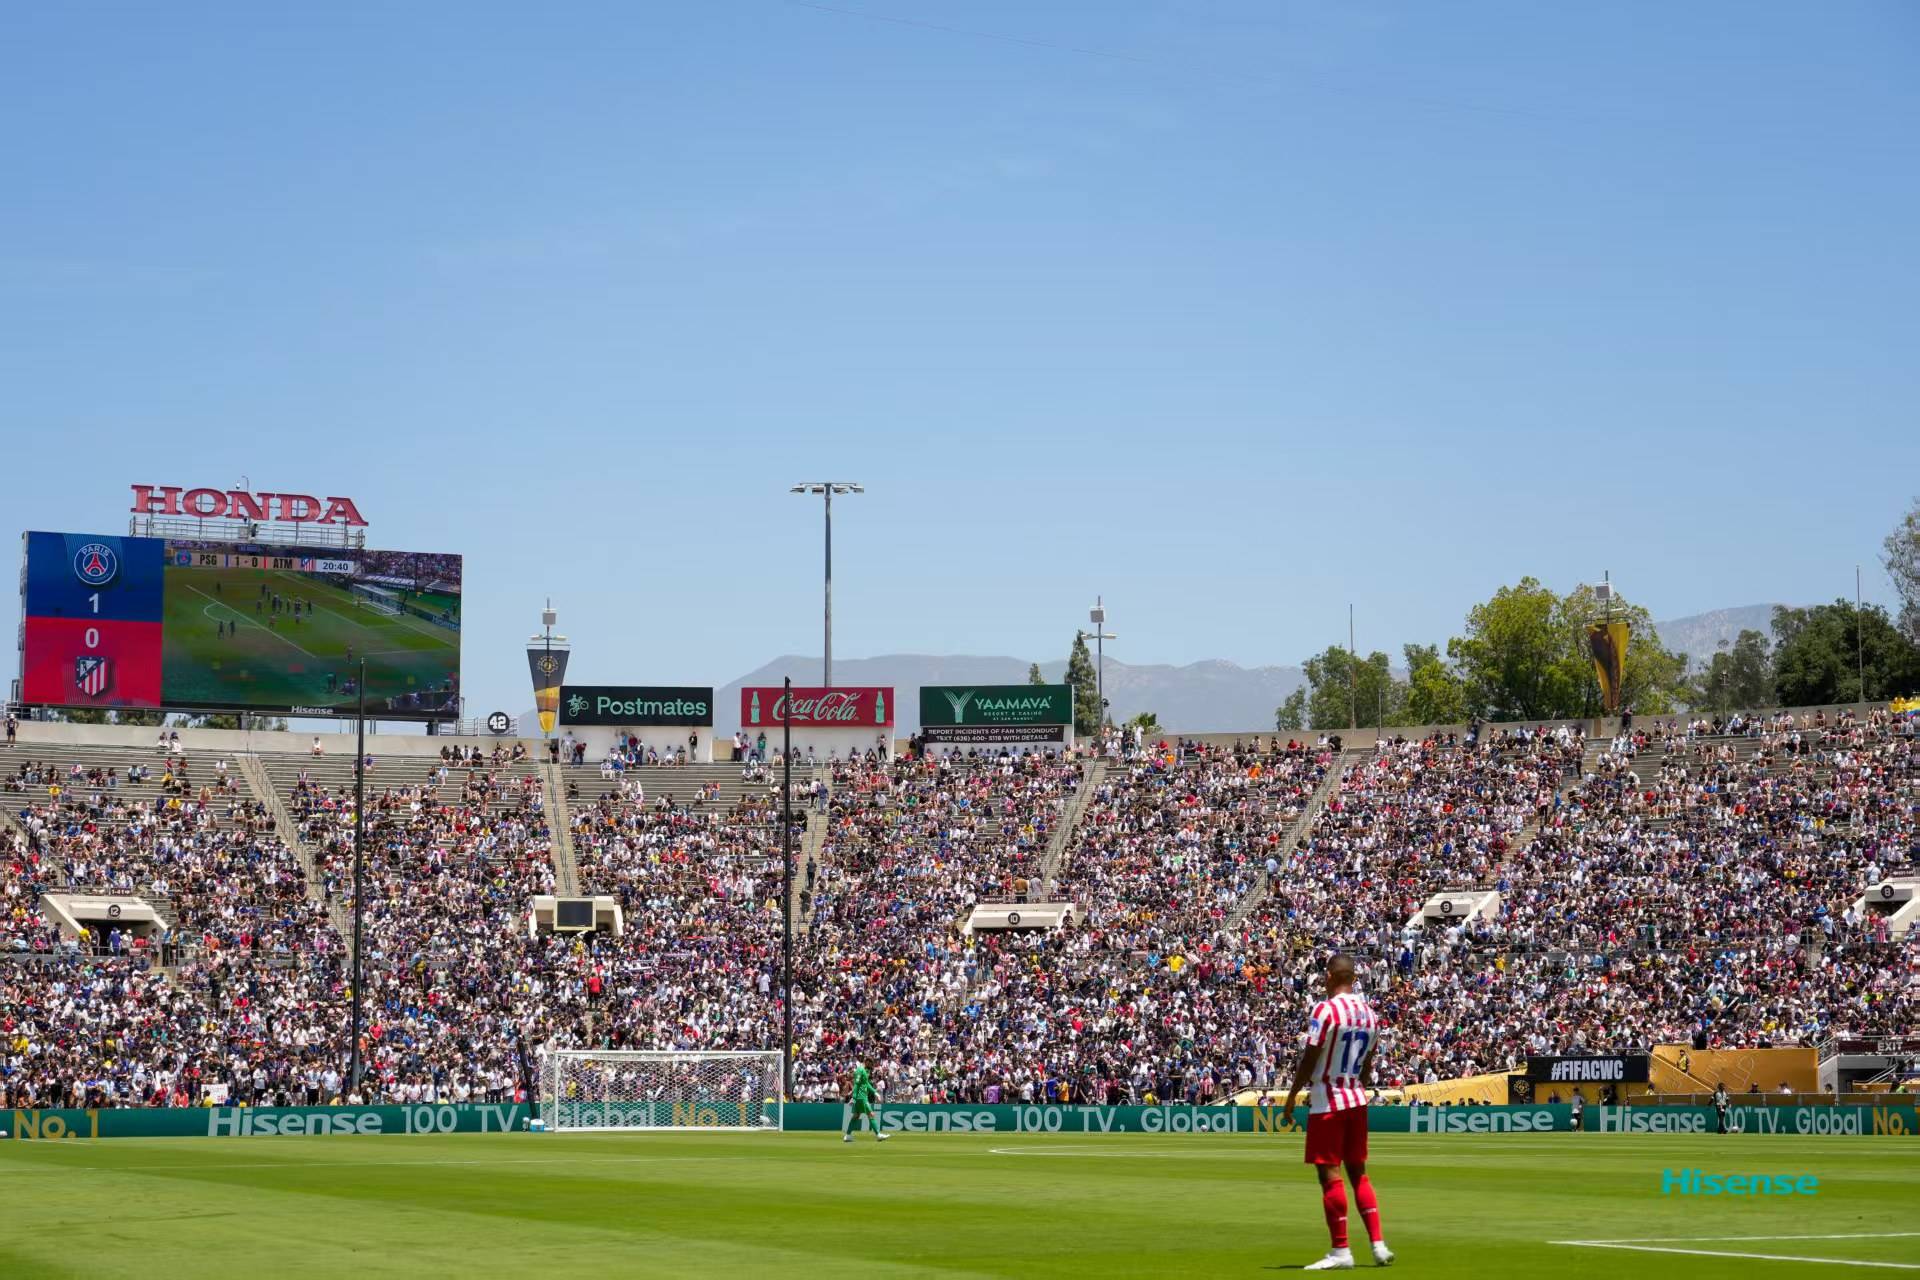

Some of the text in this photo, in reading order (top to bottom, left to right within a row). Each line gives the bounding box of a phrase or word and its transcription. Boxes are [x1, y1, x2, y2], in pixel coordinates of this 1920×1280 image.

[131, 484, 369, 527] HONDA
[81, 545, 110, 557] PARIS
[200, 554, 217, 566] PSG
[235, 556, 240, 567] 1
[252, 557, 258, 568] 0
[273, 558, 293, 569] ATM
[323, 561, 349, 572] 20:40
[88, 593, 99, 614] 1
[85, 628, 99, 648] 0
[291, 705, 334, 715] Hisense
[597, 696, 707, 716] Postmates
[489, 715, 506, 730] 42
[110, 906, 119, 915] 12
[1010, 914, 1017, 923] 10
[1341, 1030, 1369, 1075] 12
[1877, 1041, 1903, 1051] EXIT
[1551, 1060, 1624, 1081] #FIFACWC
[13, 1111, 98, 1138] No. 1
[208, 1107, 383, 1136] Hisense
[475, 1105, 518, 1133] TV
[1141, 1107, 1238, 1133] Global
[1253, 1107, 1302, 1133] No.
[1410, 1106, 1554, 1133] Hisense
[1601, 1105, 1706, 1133] Hisense
[1796, 1107, 1863, 1135] Global
[1872, 1106, 1910, 1136] No.
